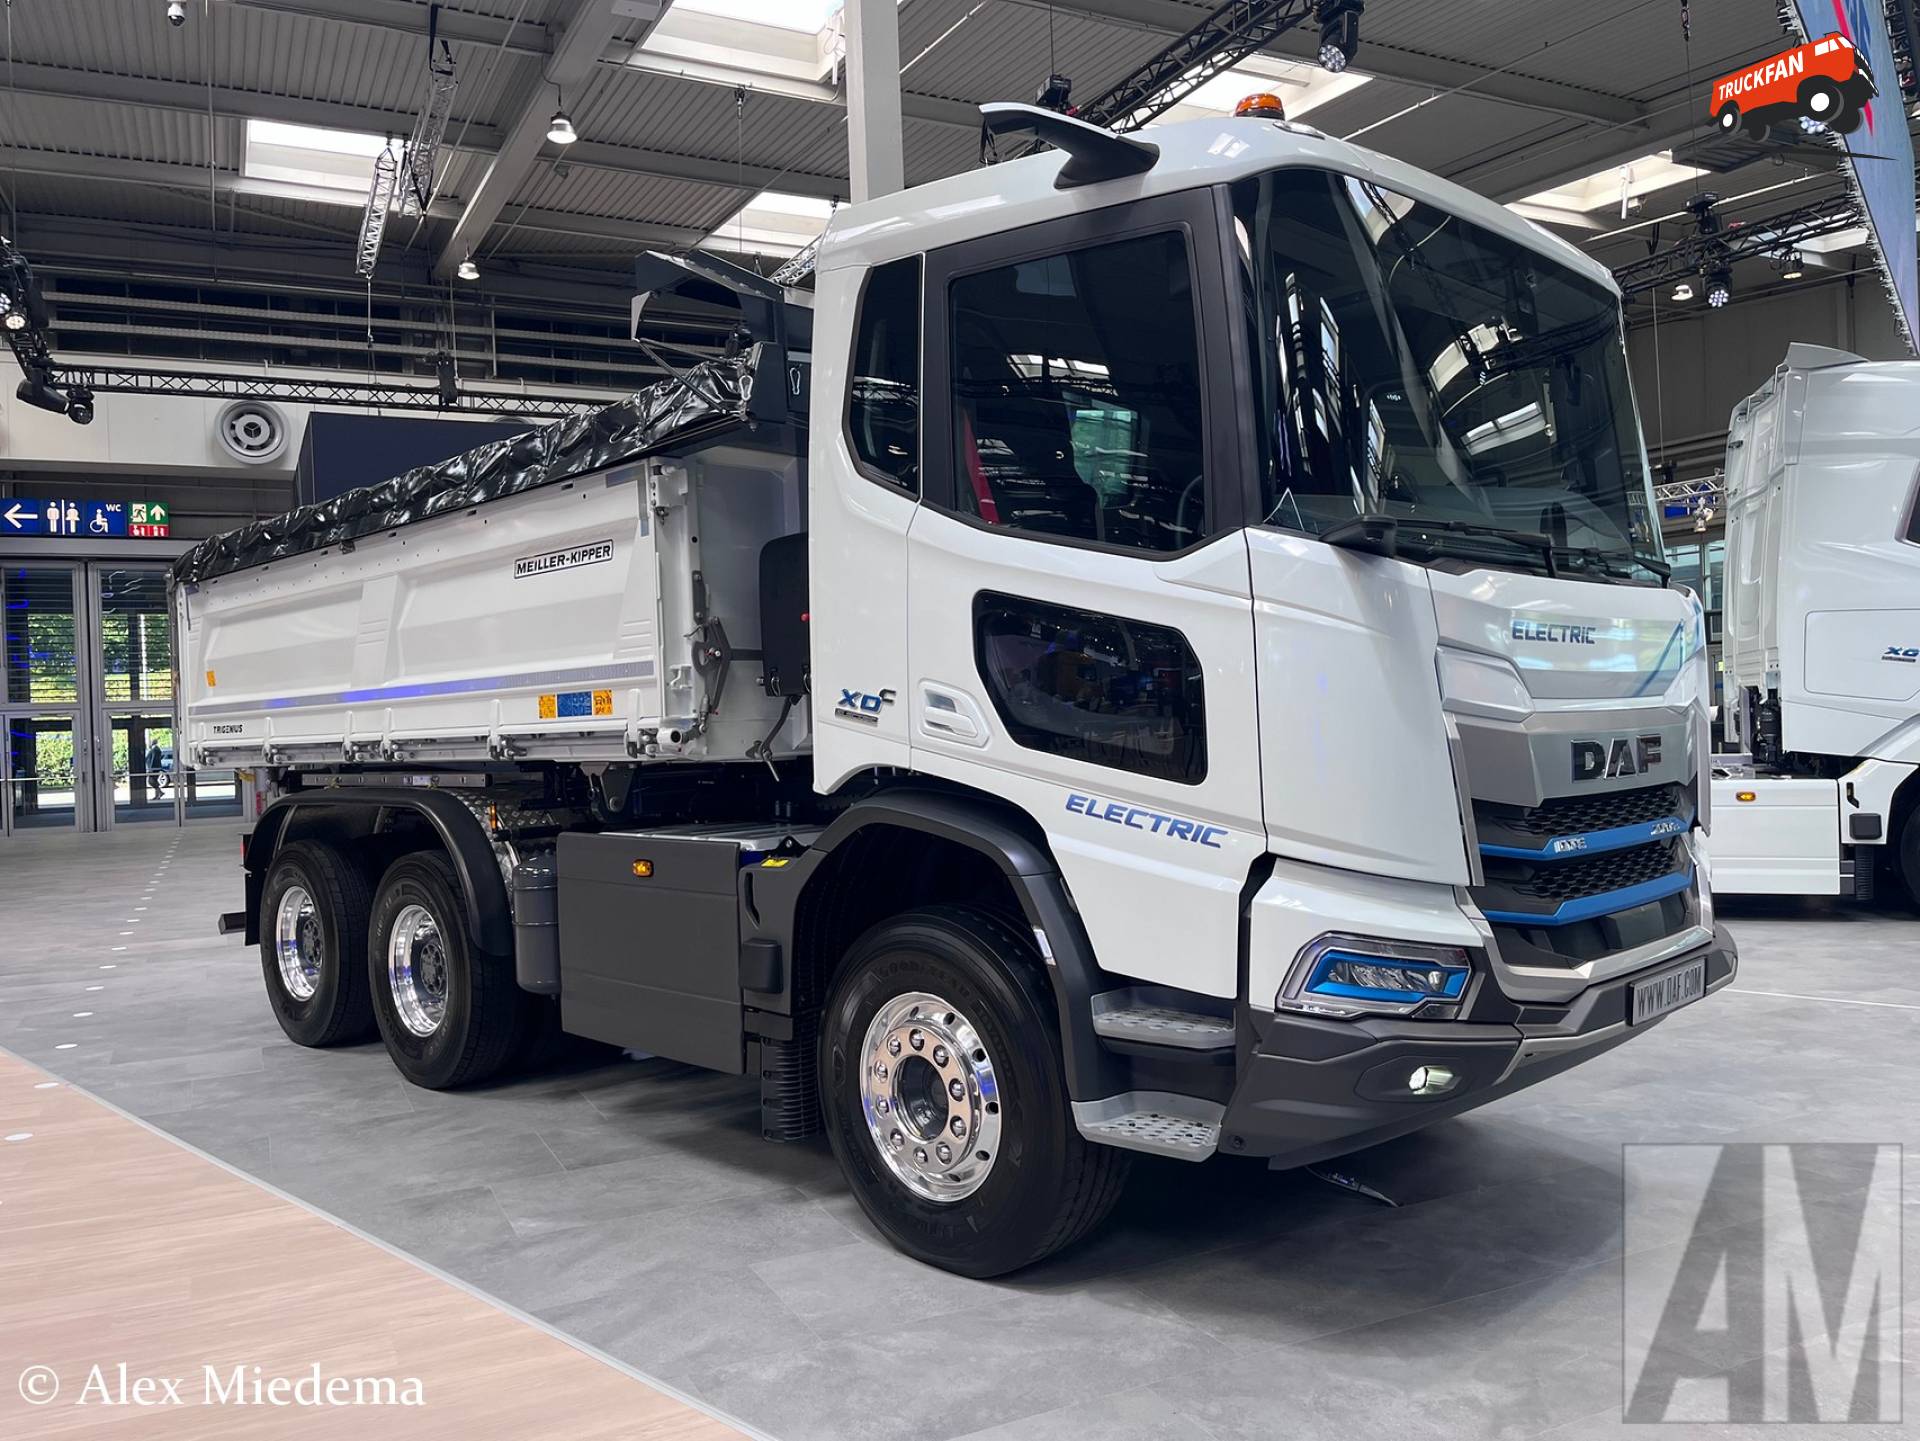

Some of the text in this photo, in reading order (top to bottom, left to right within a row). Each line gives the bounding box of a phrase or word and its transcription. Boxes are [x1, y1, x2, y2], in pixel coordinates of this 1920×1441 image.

[105, 503, 122, 512] WC
[516, 545, 611, 575] MEILLER-KIPPER
[1511, 620, 1597, 645] ELECTRIC
[1570, 733, 1662, 783] DAF
[1065, 793, 1229, 849] ELECTRIC
